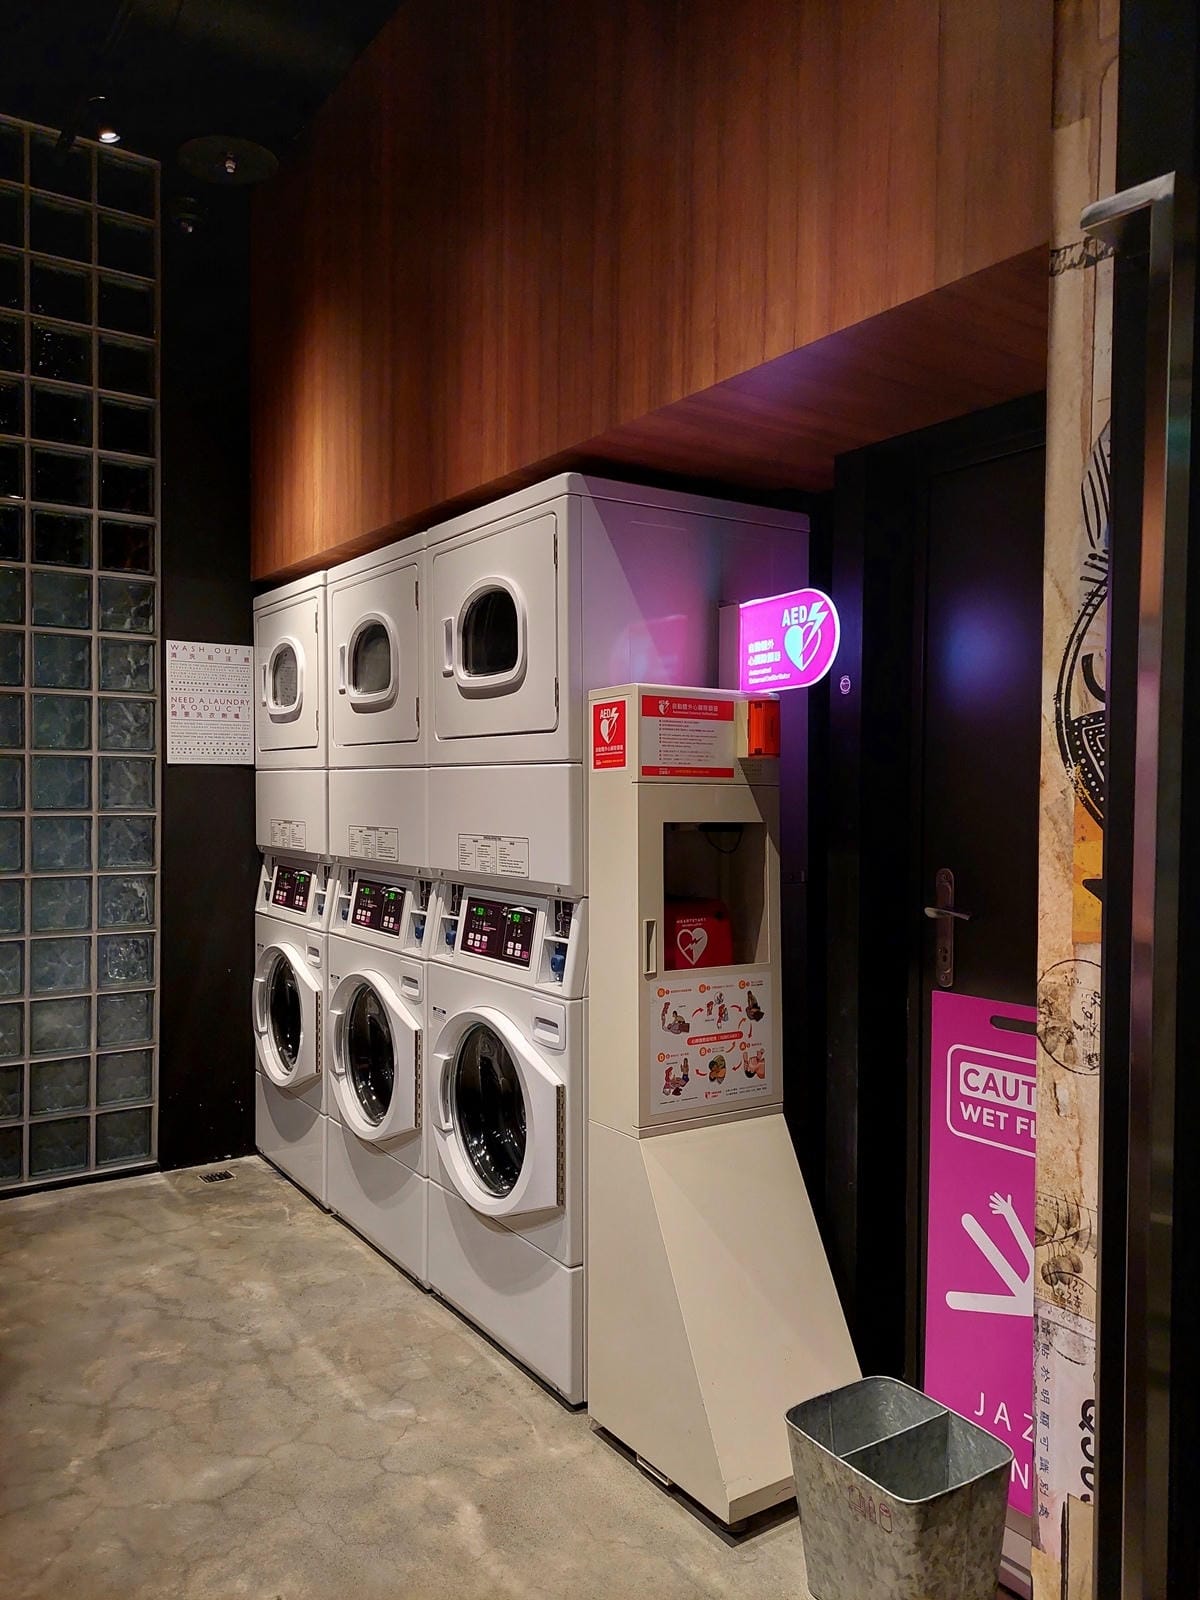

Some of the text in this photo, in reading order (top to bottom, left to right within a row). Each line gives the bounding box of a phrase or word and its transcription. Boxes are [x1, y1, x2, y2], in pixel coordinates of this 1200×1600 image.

[782, 605, 808, 627] AED
[170, 644, 205, 652] WASH
[214, 647, 239, 655] OUT
[170, 696, 195, 704] NEED
[208, 698, 250, 706] LAUNDRY
[170, 704, 242, 713] PRODUCT
[600, 708, 611, 720] AED
[963, 1068, 1037, 1106] CAUT
[959, 1101, 1009, 1131] WET
